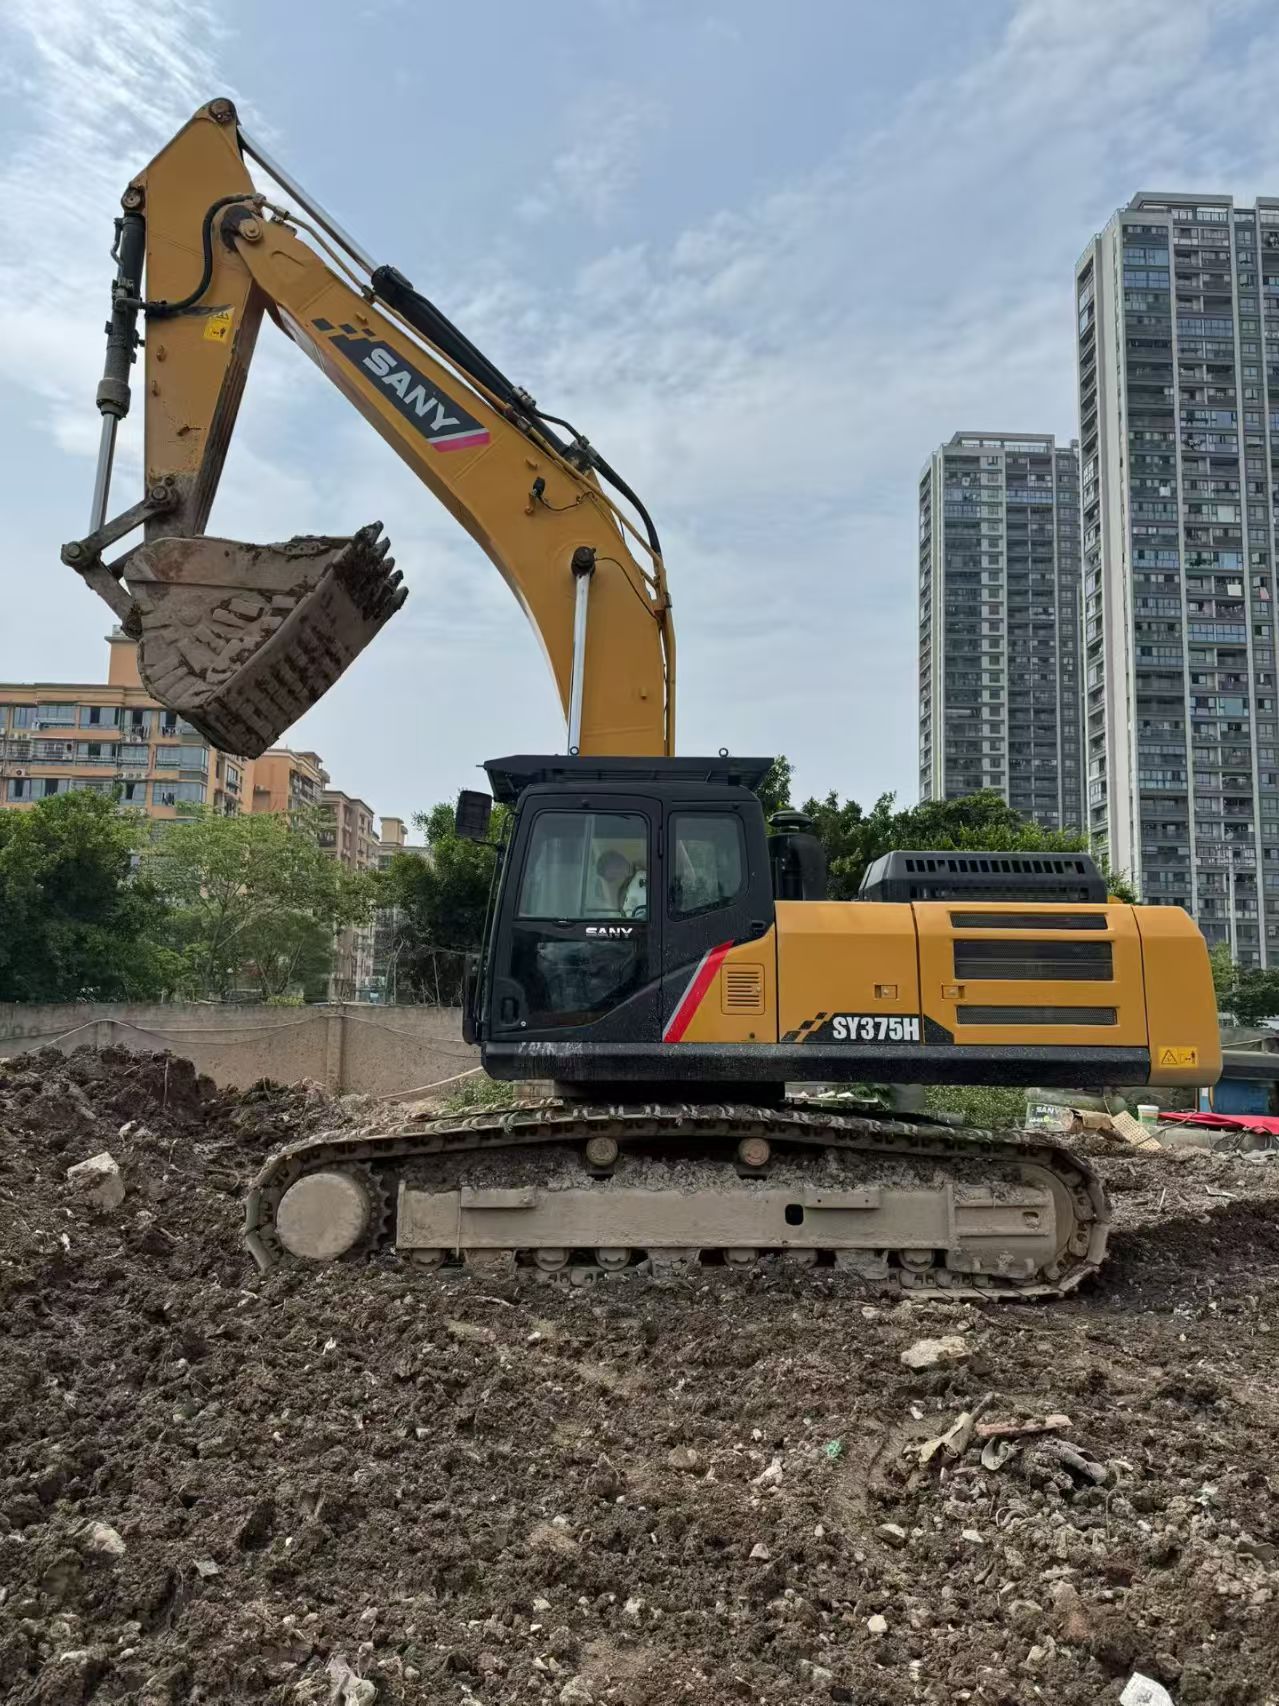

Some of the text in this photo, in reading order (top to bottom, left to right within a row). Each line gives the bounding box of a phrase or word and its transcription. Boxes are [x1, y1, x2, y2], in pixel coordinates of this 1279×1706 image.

[362, 347, 461, 431] SANY
[585, 927, 633, 938] SANY
[832, 1016, 920, 1041] SY375H
